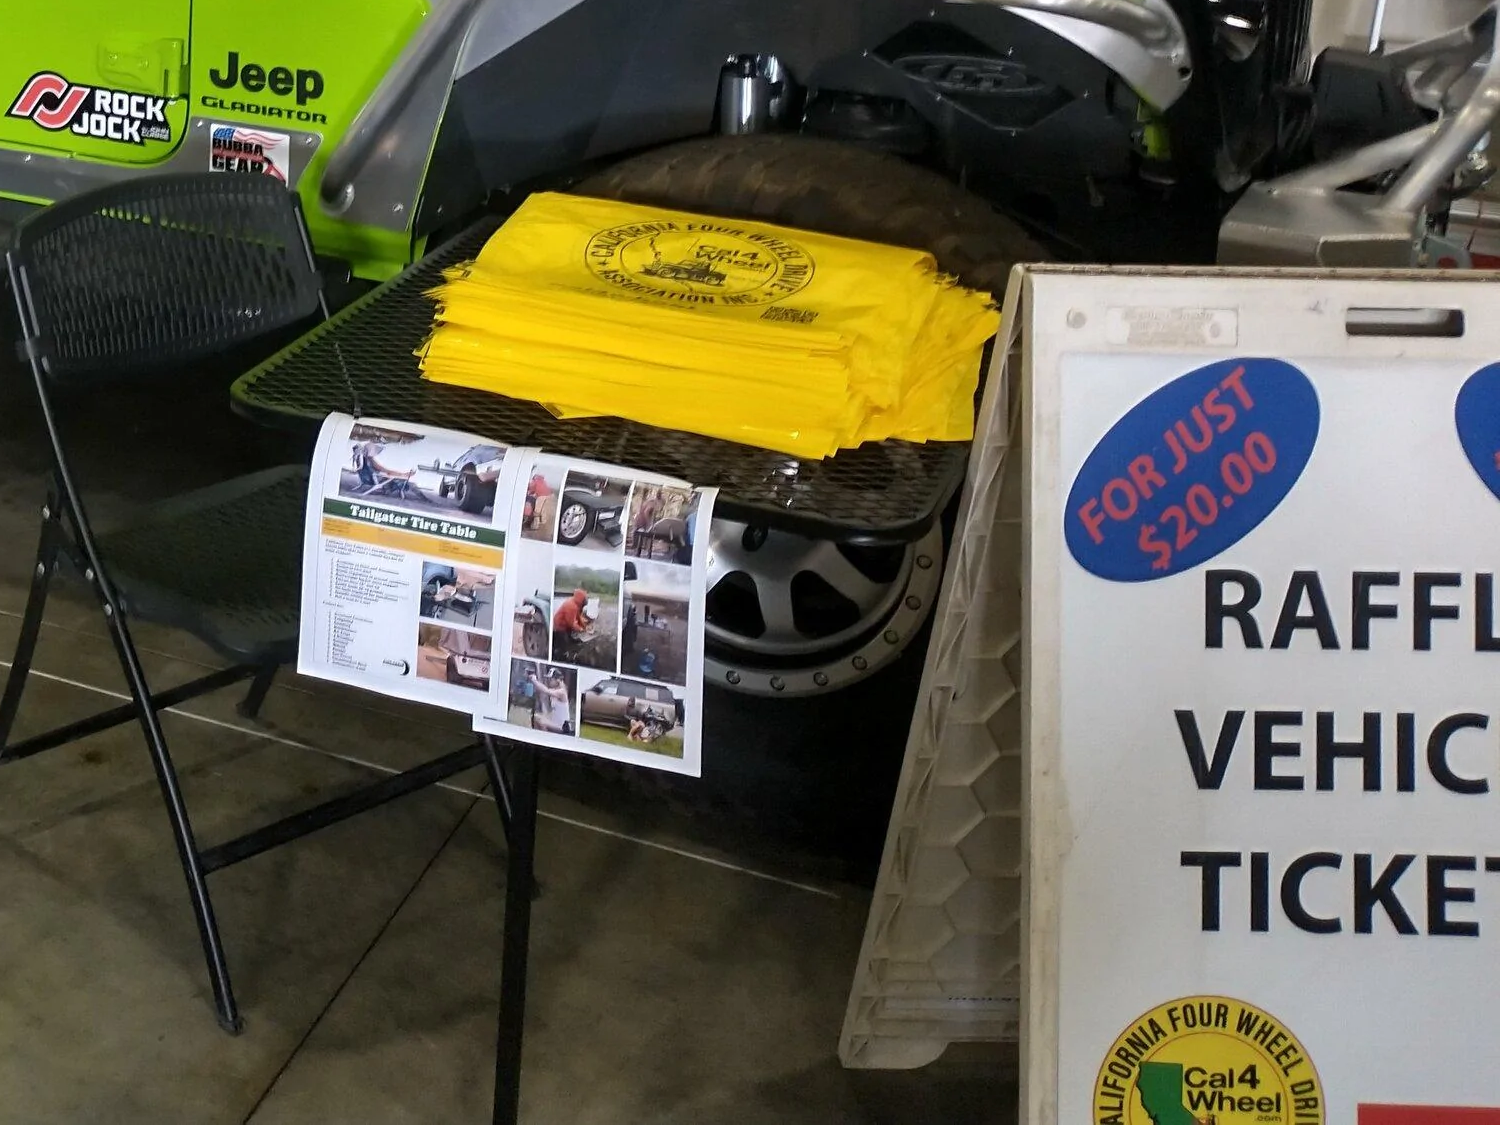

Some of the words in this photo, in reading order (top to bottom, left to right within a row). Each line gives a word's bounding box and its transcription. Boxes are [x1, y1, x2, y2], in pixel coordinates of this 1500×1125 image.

[209, 51, 325, 106] Jeep
[94, 88, 165, 122] ROCK
[201, 95, 328, 124] GLADIATOR
[71, 111, 141, 143] JOCK
[212, 138, 263, 157] BUBBA
[591, 222, 680, 258] CALIFORNIA
[686, 223, 744, 236] FOUR
[747, 233, 803, 262] WHEEL
[598, 269, 716, 305] ASSOCIATION
[771, 263, 808, 293] DRIVE
[1078, 455, 1167, 545] FOR
[1163, 365, 1255, 475] JUST
[1138, 431, 1277, 570] $20.00
[350, 504, 409, 527] Tailgater
[411, 517, 438, 533] Tire
[441, 522, 478, 539] Table
[1174, 709, 1490, 794] VEHIC
[1166, 1002, 1230, 1032] FOUR
[1235, 1008, 1304, 1077] WHEEL
[1290, 1079, 1319, 1125] DRI
[1186, 1090, 1282, 1113] Wheel
